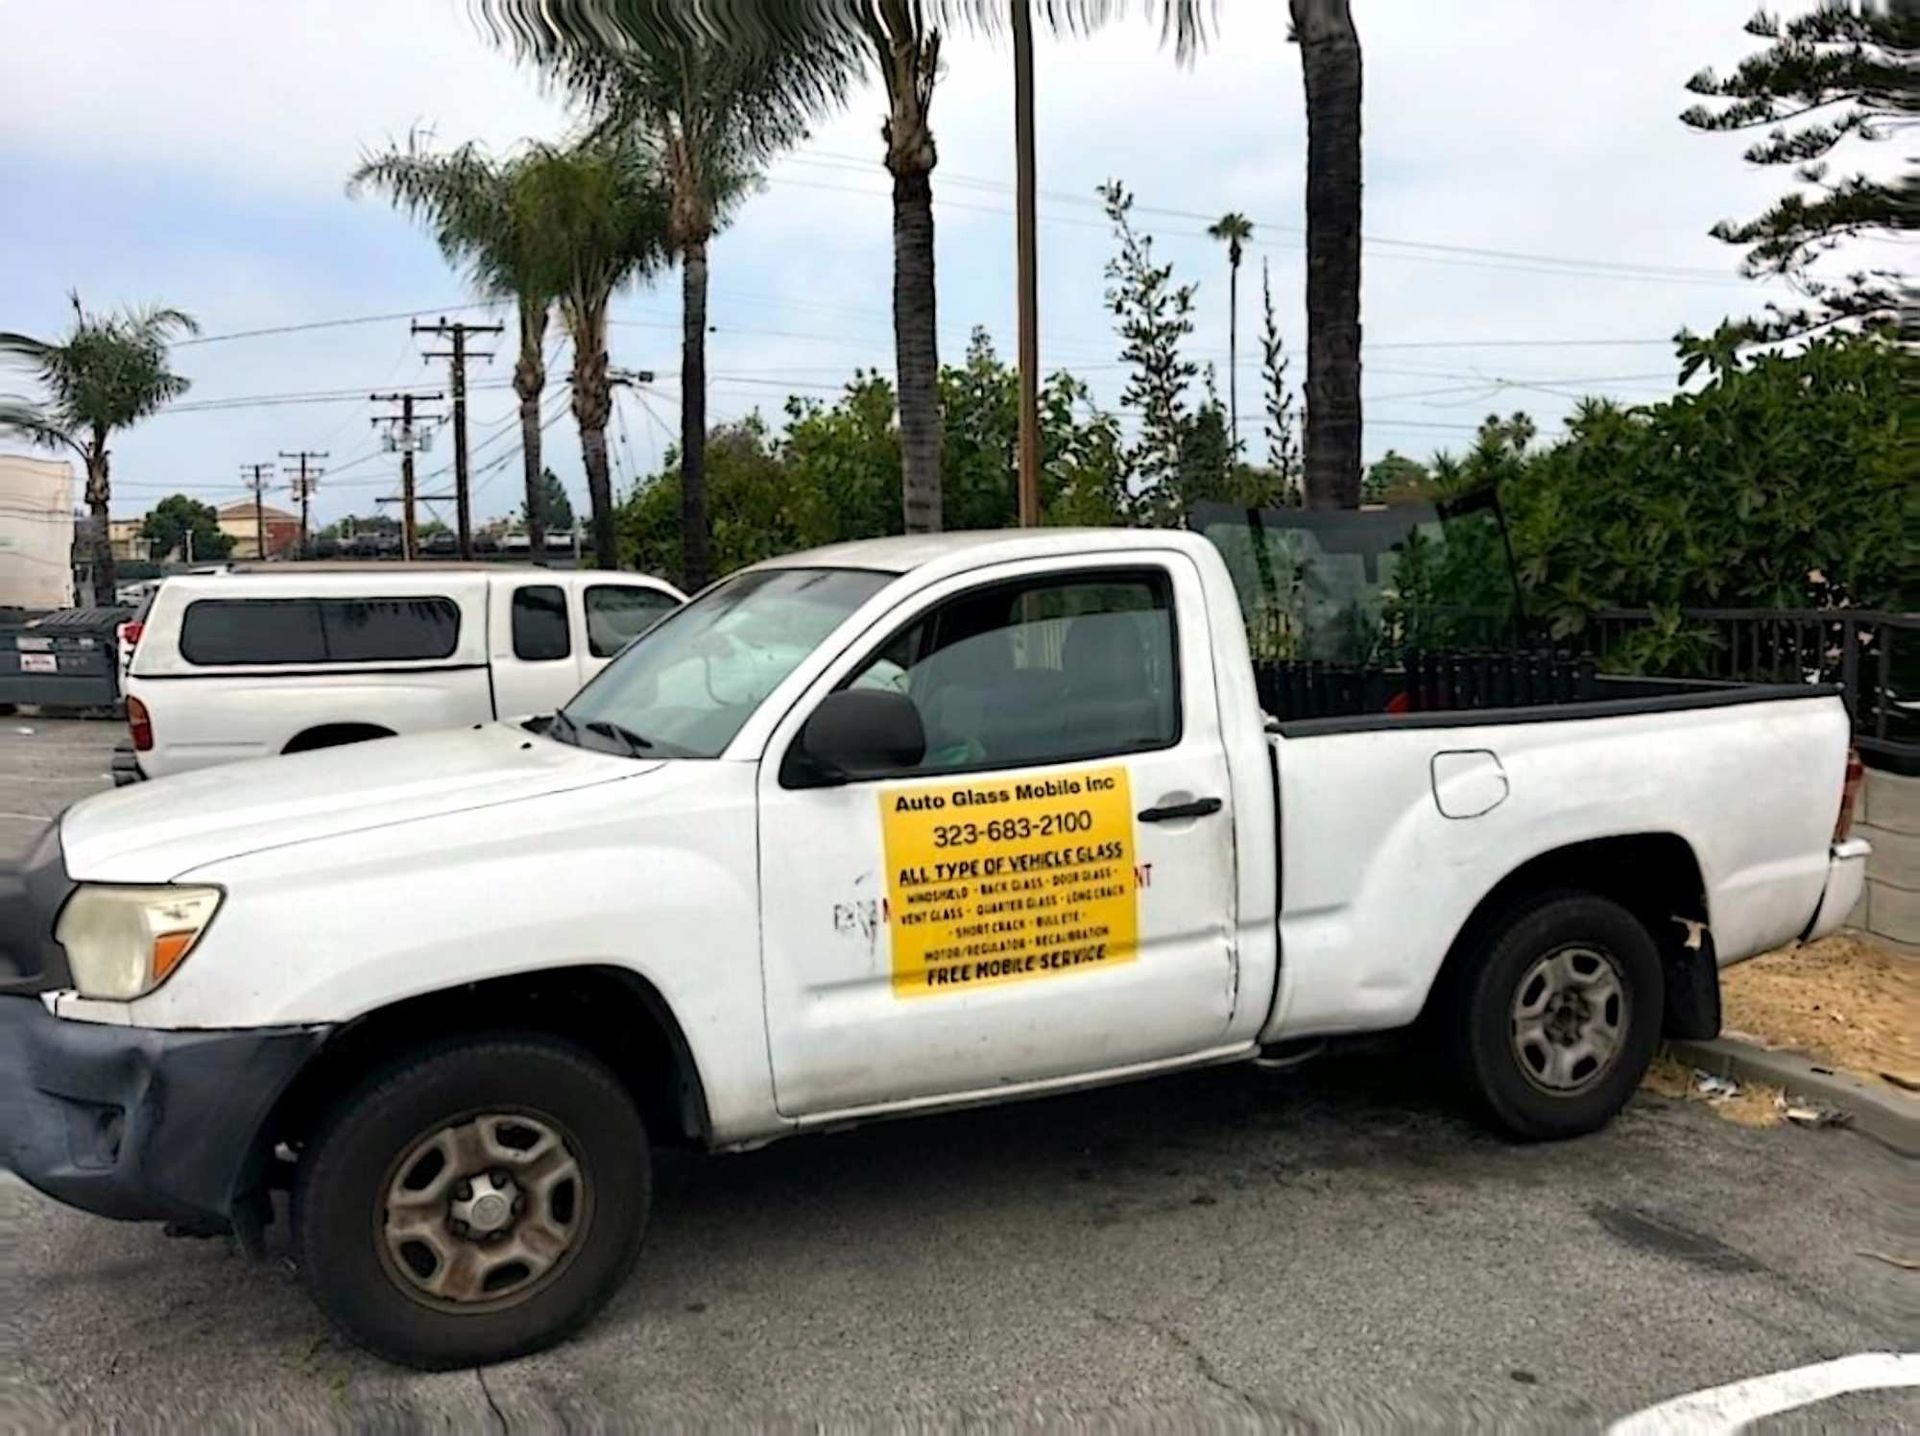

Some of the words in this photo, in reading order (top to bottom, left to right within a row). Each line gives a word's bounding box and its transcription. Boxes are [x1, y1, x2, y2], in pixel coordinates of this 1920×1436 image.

[895, 795, 945, 812] Auto
[952, 789, 1010, 806] Glass
[1015, 780, 1081, 801] Mobile
[933, 809, 1092, 848] 323-683-2100
[899, 867, 929, 887] ALL
[934, 859, 979, 881] TYPE
[984, 856, 1004, 876] OF
[1009, 848, 1073, 872] VEHICLE
[1076, 842, 1123, 864] GLASS
[907, 886, 968, 904] WINDSHIELD
[980, 881, 1007, 896] BACK
[1011, 877, 1043, 891] GLASS
[1053, 871, 1079, 886] DOOR
[1083, 867, 1112, 882] GLASS
[930, 907, 963, 923] GLASS
[976, 899, 1023, 916] QUARTER
[1026, 895, 1058, 910] GLASS
[1093, 884, 1125, 900] CRACK
[955, 922, 990, 939] SHORT
[992, 919, 1025, 934] CRACK
[927, 964, 972, 986] FREE
[976, 955, 1035, 979] MOBILE
[1040, 943, 1107, 970] SERVICE
